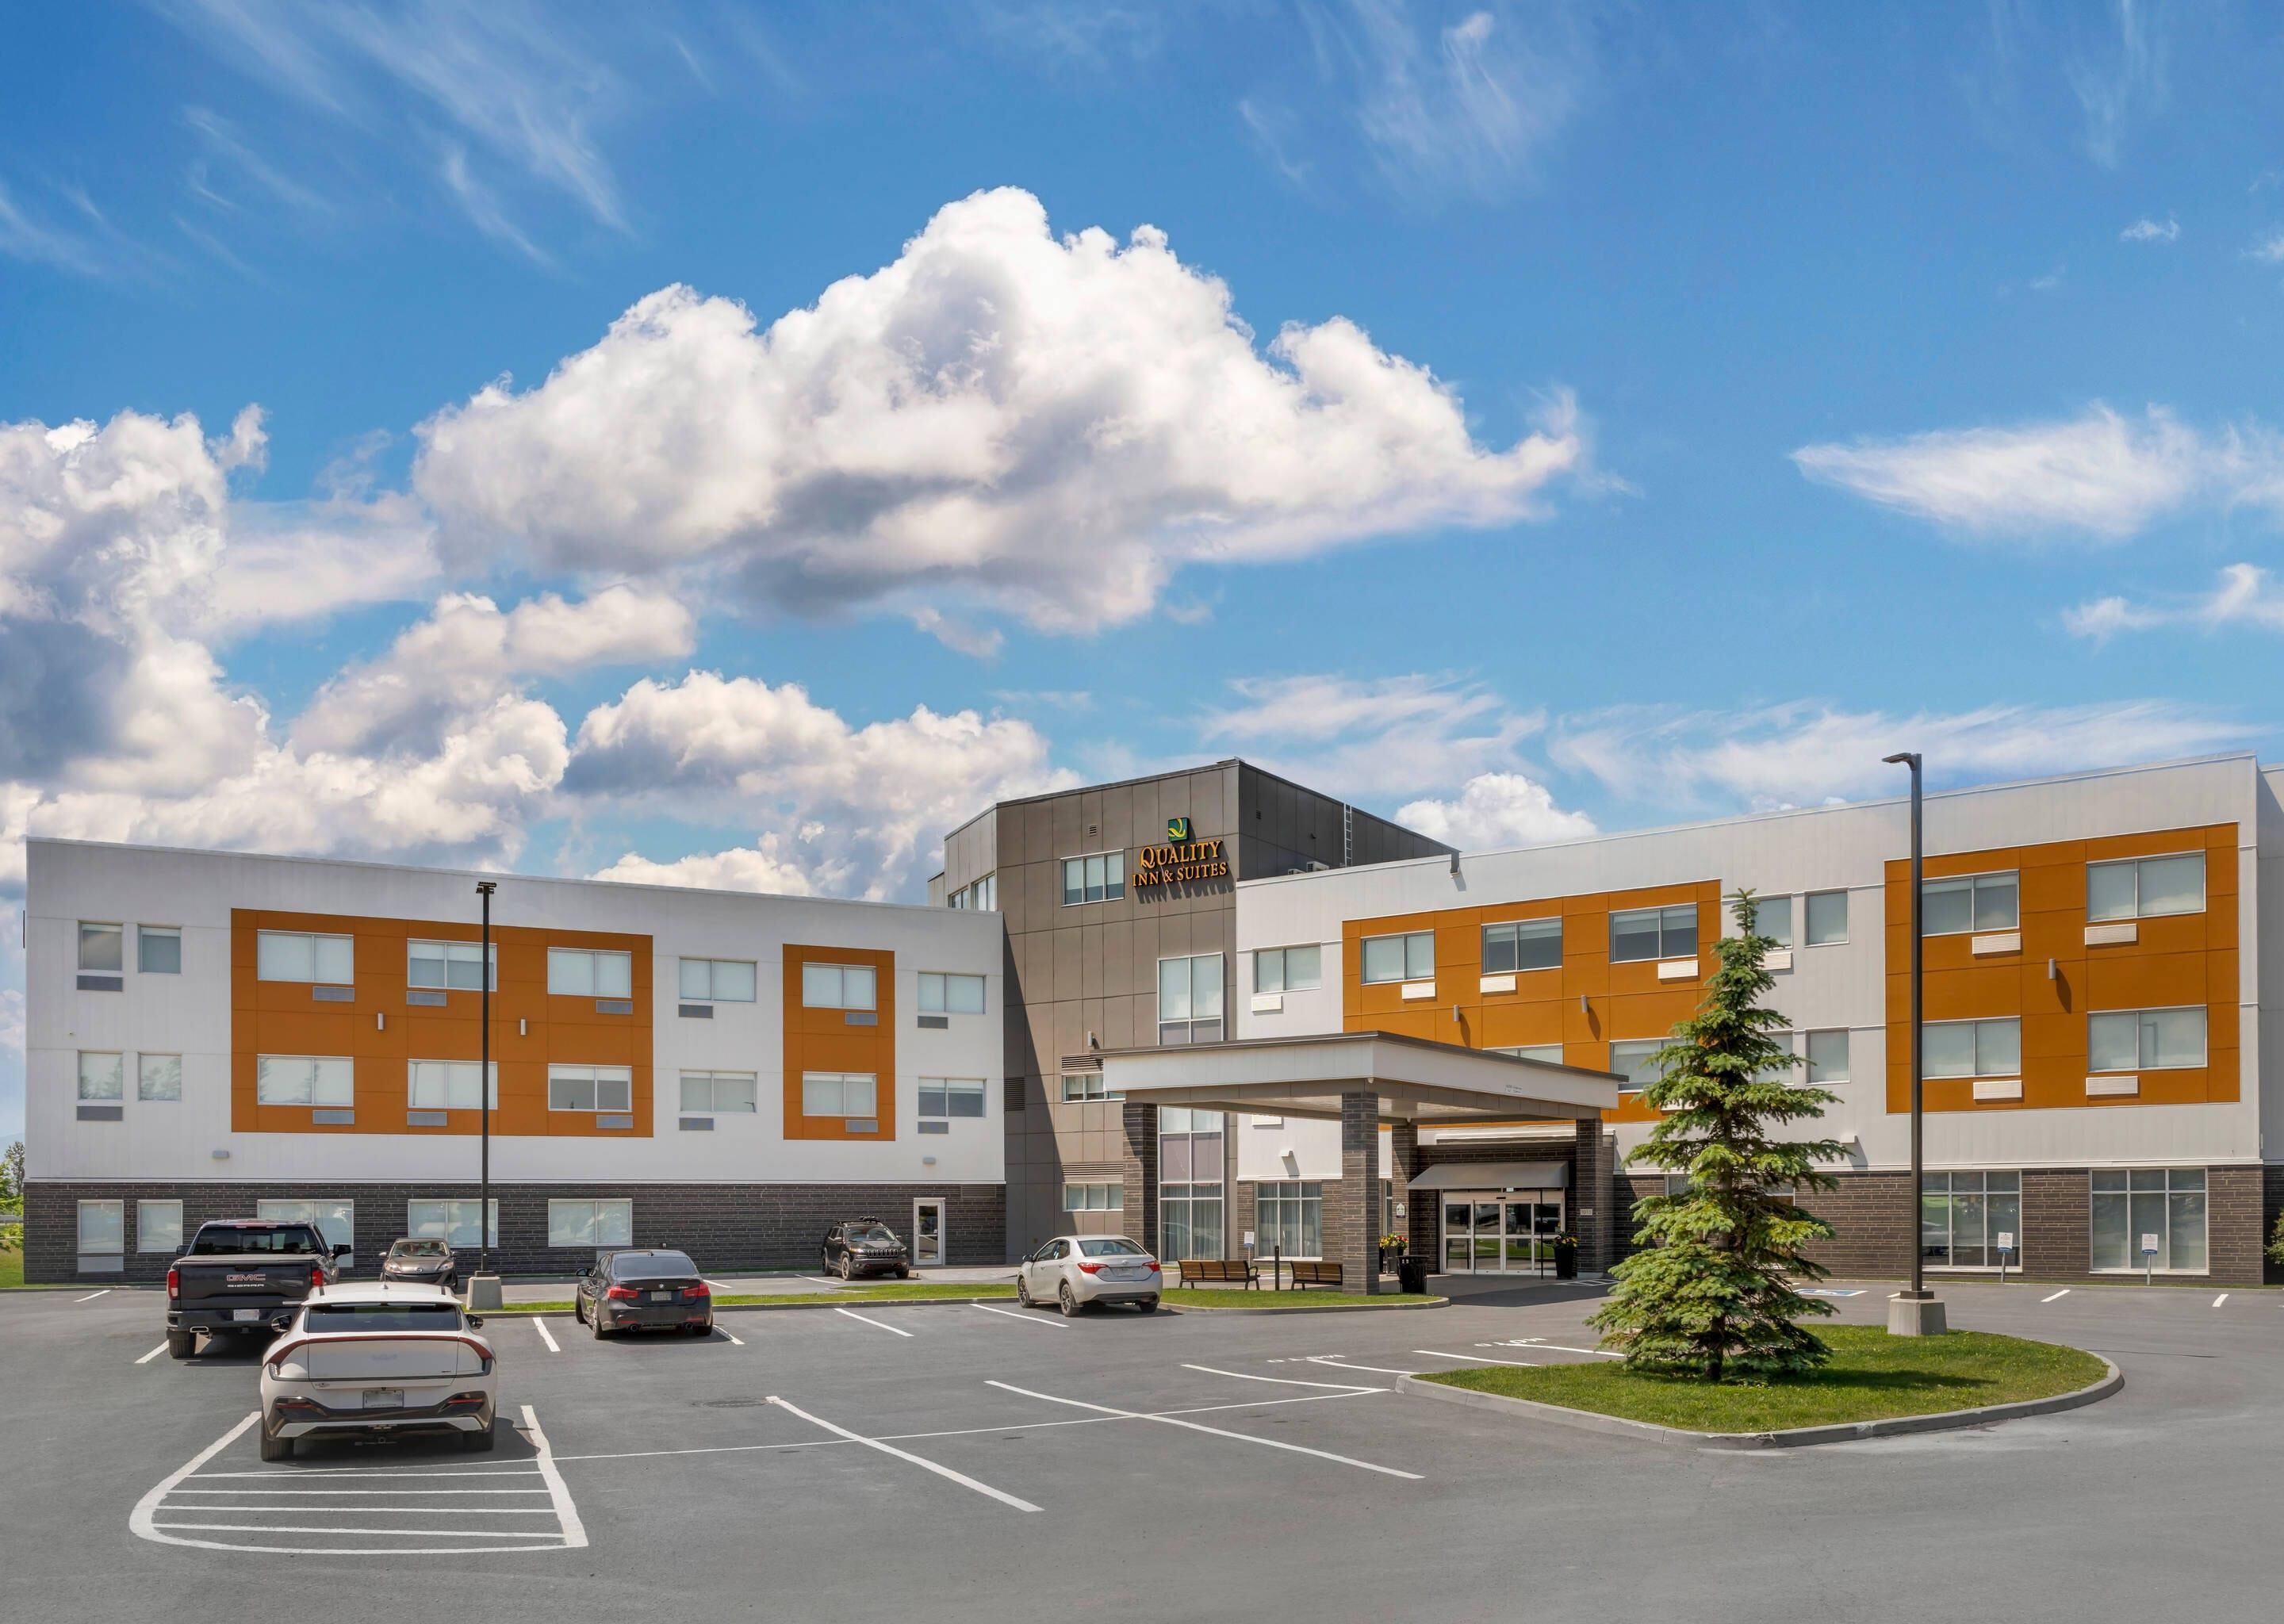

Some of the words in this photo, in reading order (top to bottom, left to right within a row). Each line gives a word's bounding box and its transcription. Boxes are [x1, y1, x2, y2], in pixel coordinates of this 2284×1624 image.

[1140, 841, 1222, 868] QUALITY
[1132, 871, 1159, 887] INN
[1163, 869, 1173, 883] &
[1177, 862, 1227, 881] SUITES
